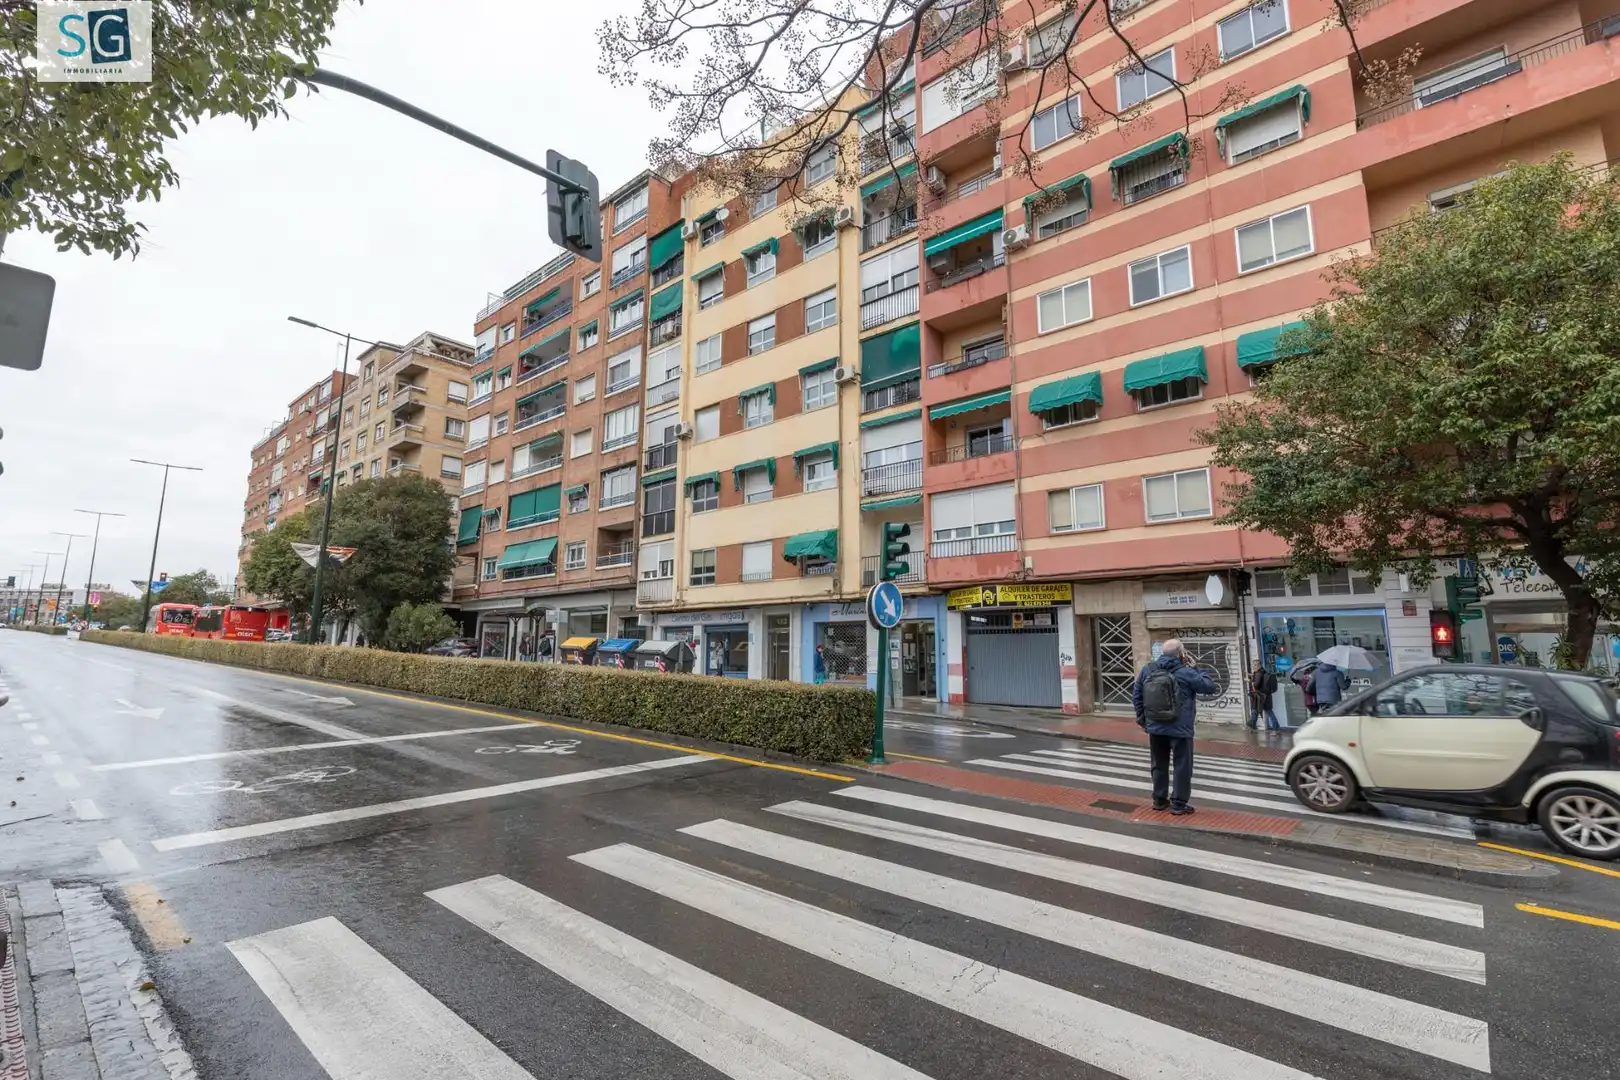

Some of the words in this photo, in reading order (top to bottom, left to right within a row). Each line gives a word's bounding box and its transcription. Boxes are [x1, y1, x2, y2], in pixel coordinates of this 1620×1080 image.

[1000, 584, 1031, 593] ALQUILER
[1031, 584, 1040, 592] DE
[1040, 584, 1069, 593] GARAJES
